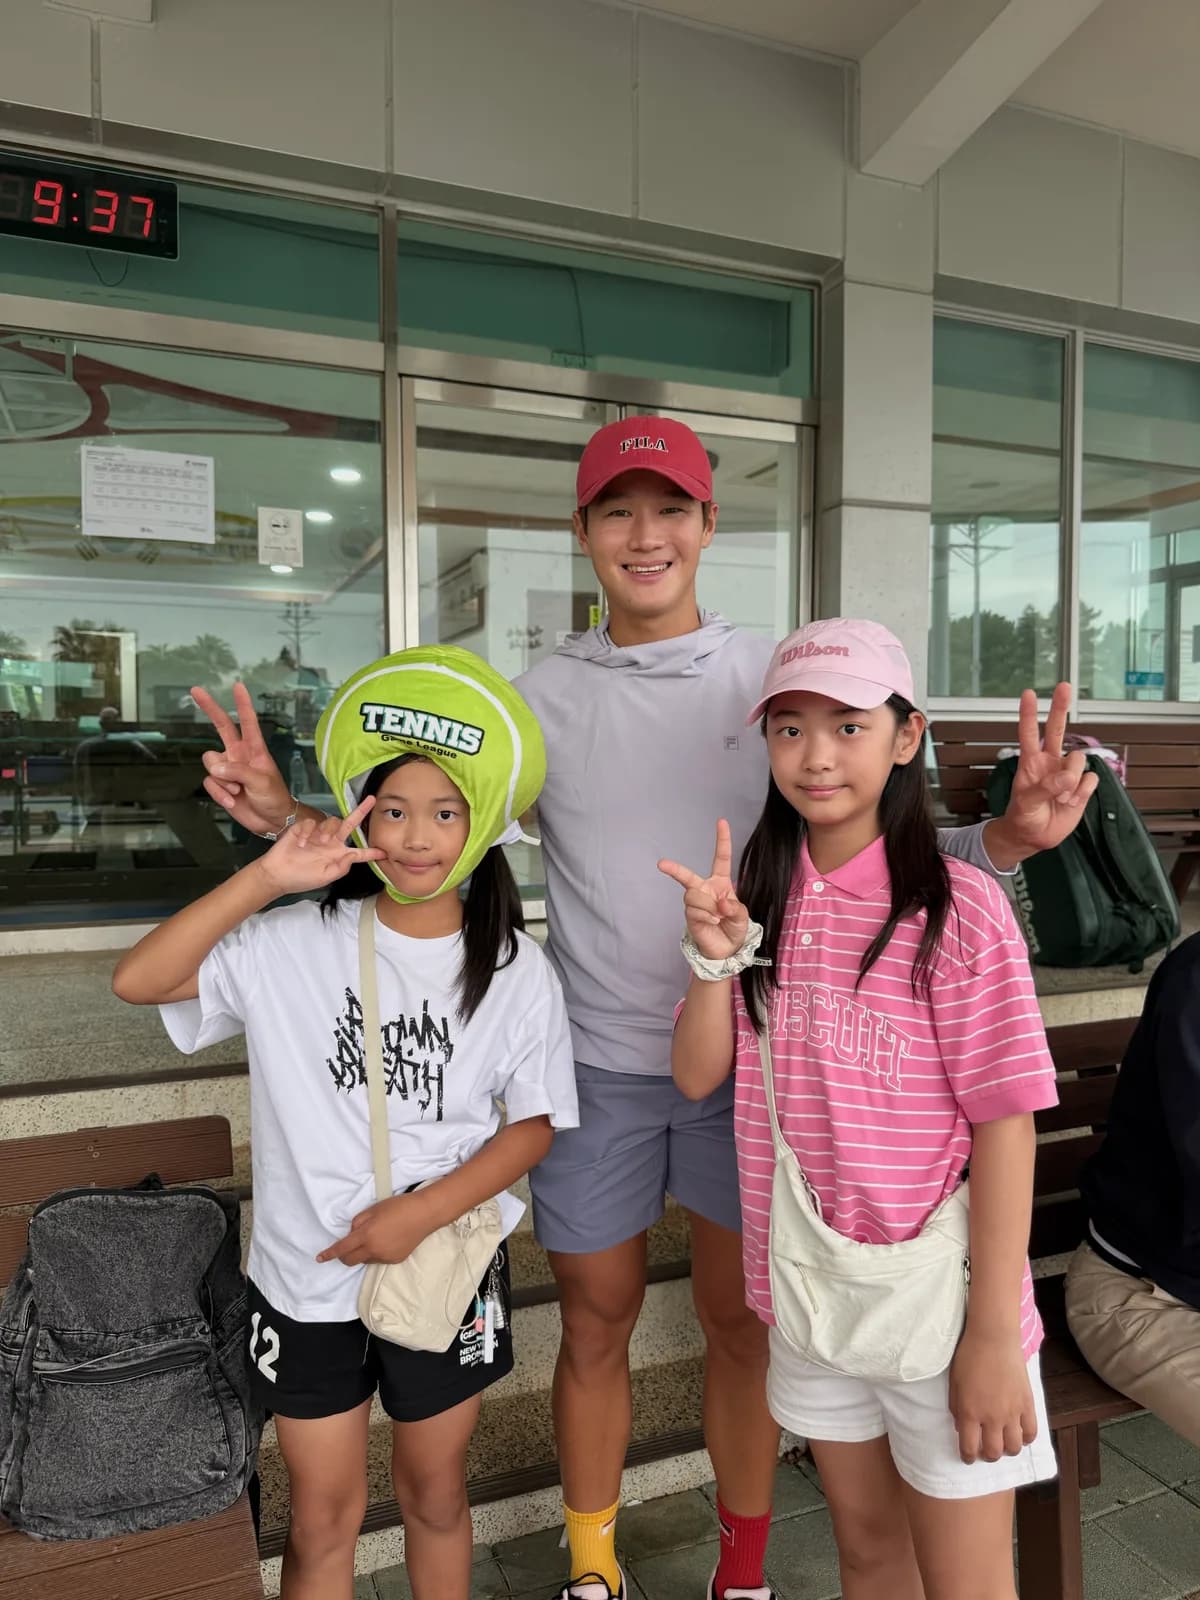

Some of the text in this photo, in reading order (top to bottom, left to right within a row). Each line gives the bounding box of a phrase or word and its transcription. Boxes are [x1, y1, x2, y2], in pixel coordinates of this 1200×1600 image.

[32, 179, 155, 238] 9:37
[619, 436, 669, 454] FILA
[780, 641, 849, 666] Wilson
[360, 702, 485, 756] TENNIS
[416, 740, 457, 759] League
[735, 983, 913, 1091] ISCUIT
